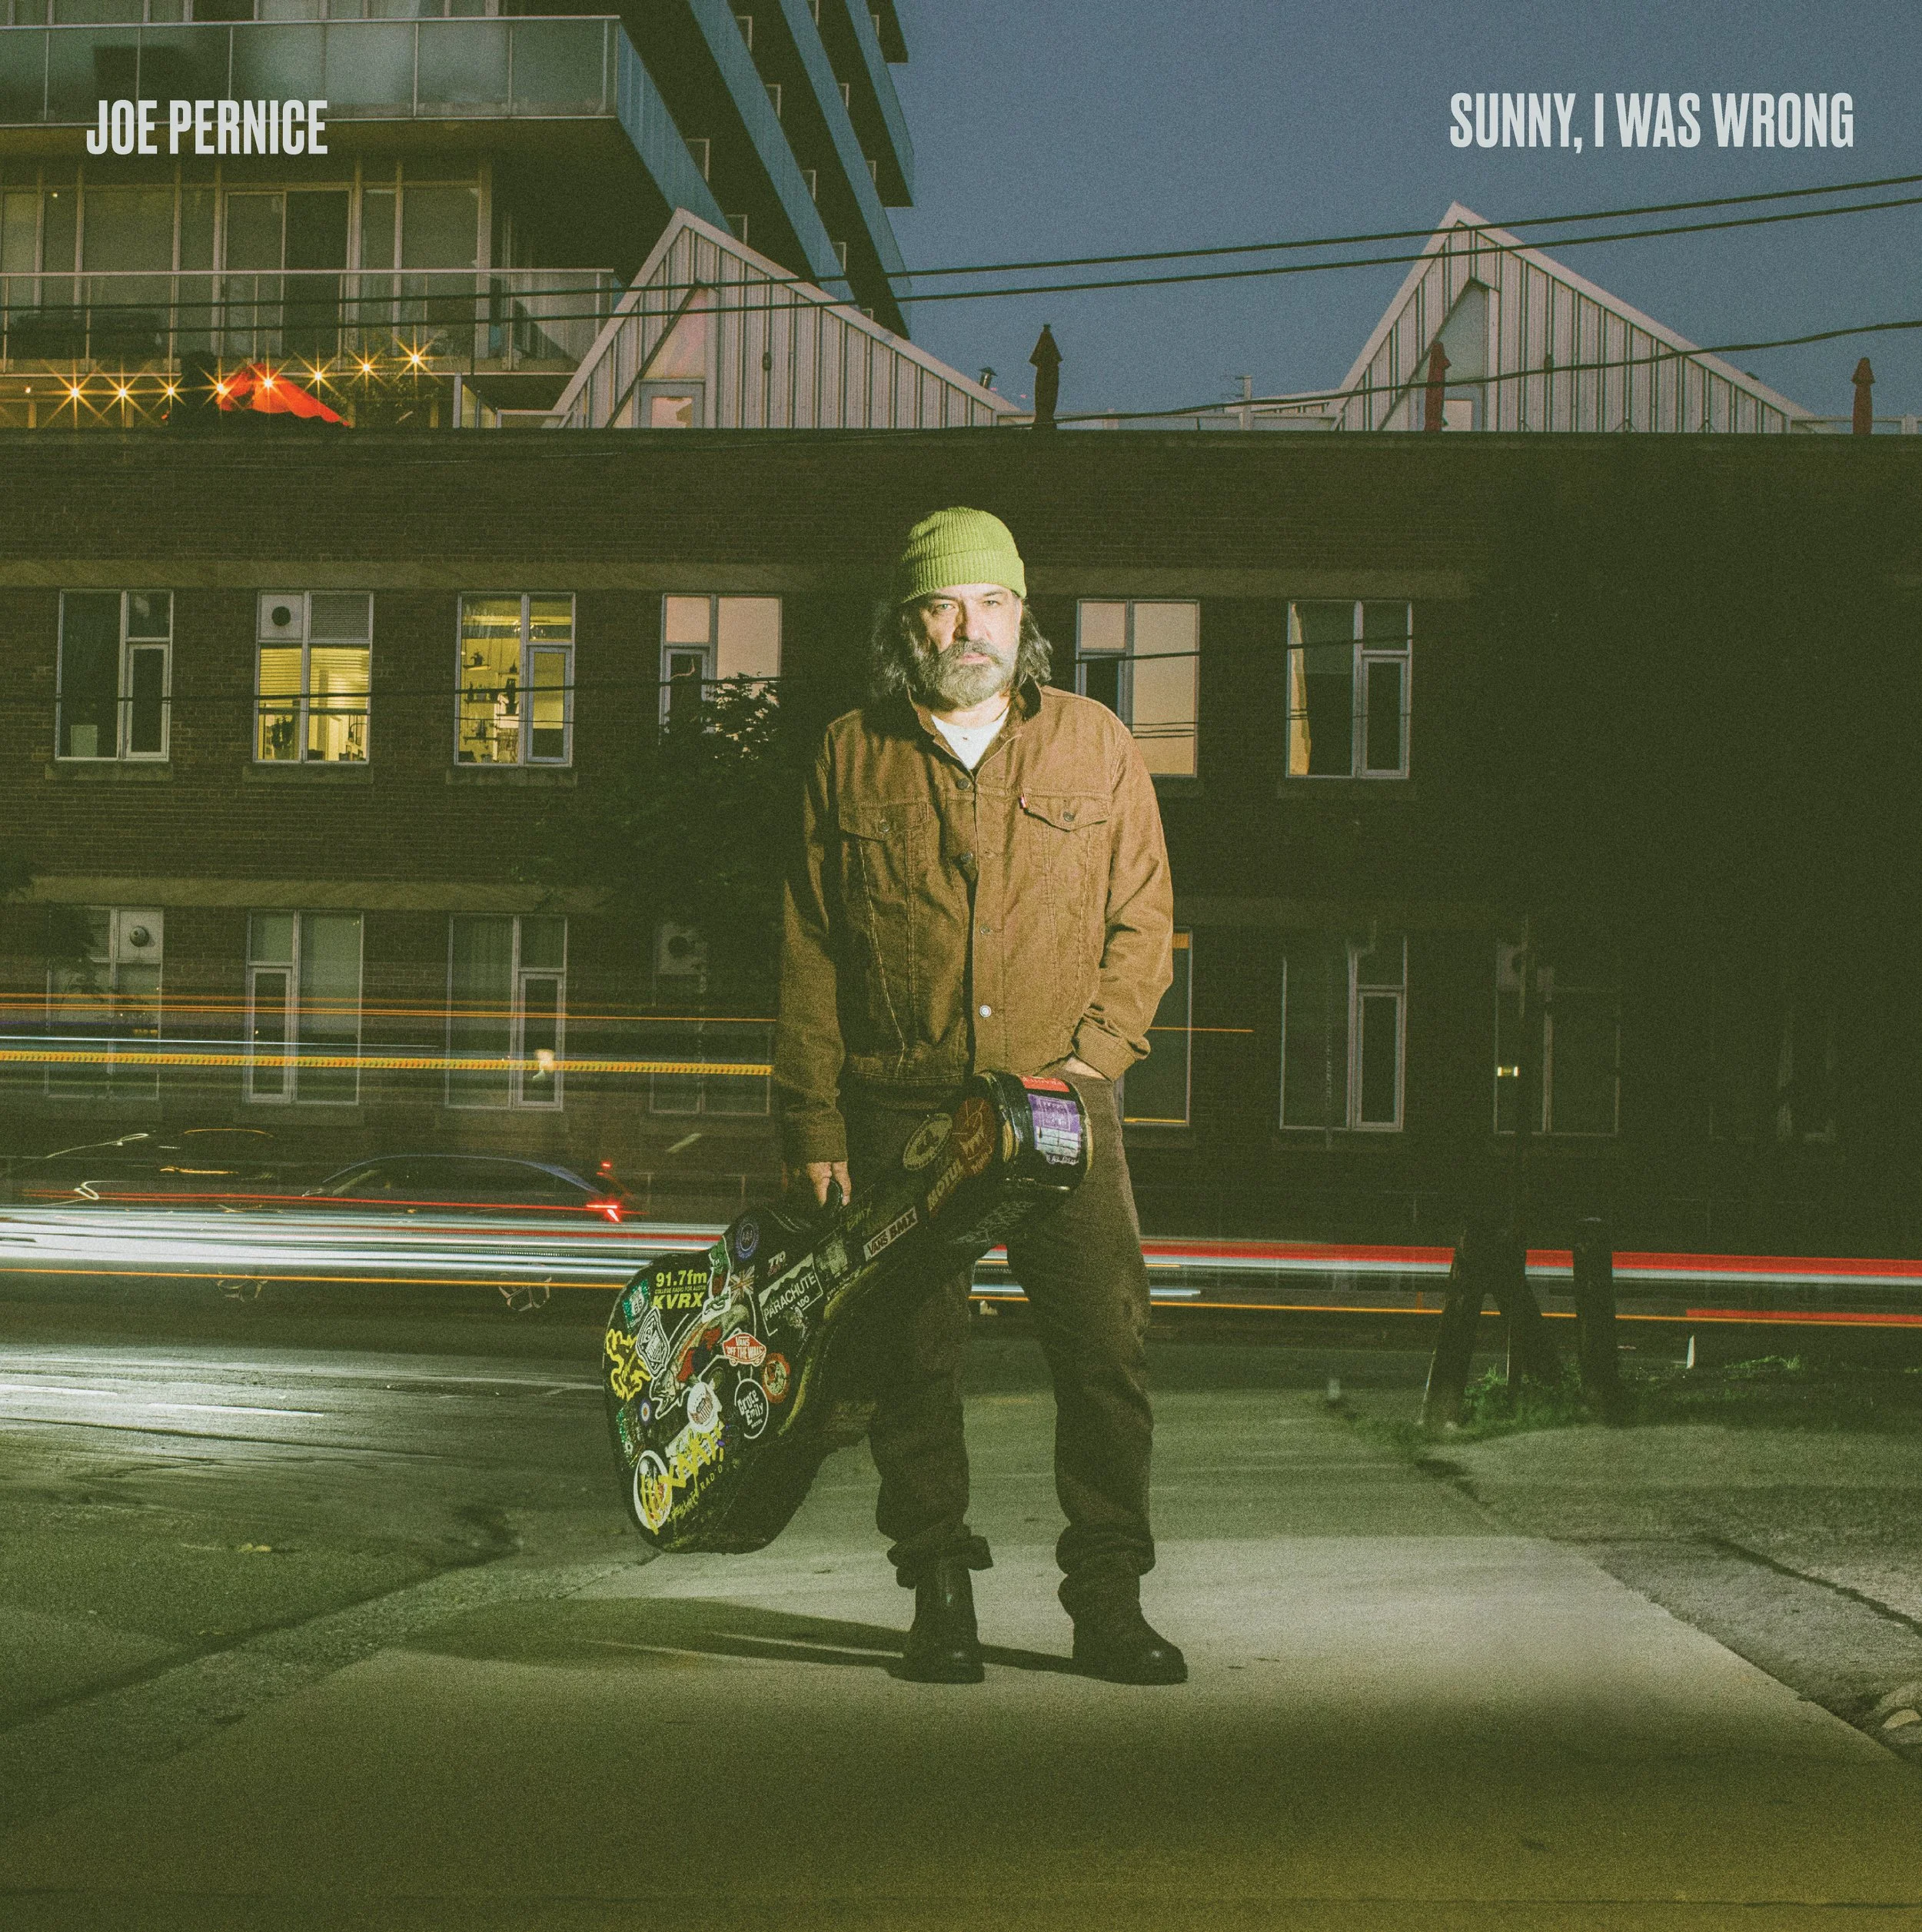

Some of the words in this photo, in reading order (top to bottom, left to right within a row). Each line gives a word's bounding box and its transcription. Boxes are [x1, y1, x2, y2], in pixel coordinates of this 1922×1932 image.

[867, 1231, 888, 1255] VANS
[890, 1209, 916, 1241] BMX
[656, 1269, 707, 1288] 91.7fm
[650, 1292, 705, 1309] KVRX
[763, 1271, 816, 1321] PARACHUTE
[736, 1336, 750, 1347] VANS
[737, 1347, 747, 1360] THE
[737, 1389, 759, 1416] Grace
[744, 1403, 763, 1426] Emily
[700, 1464, 723, 1491] RADO
